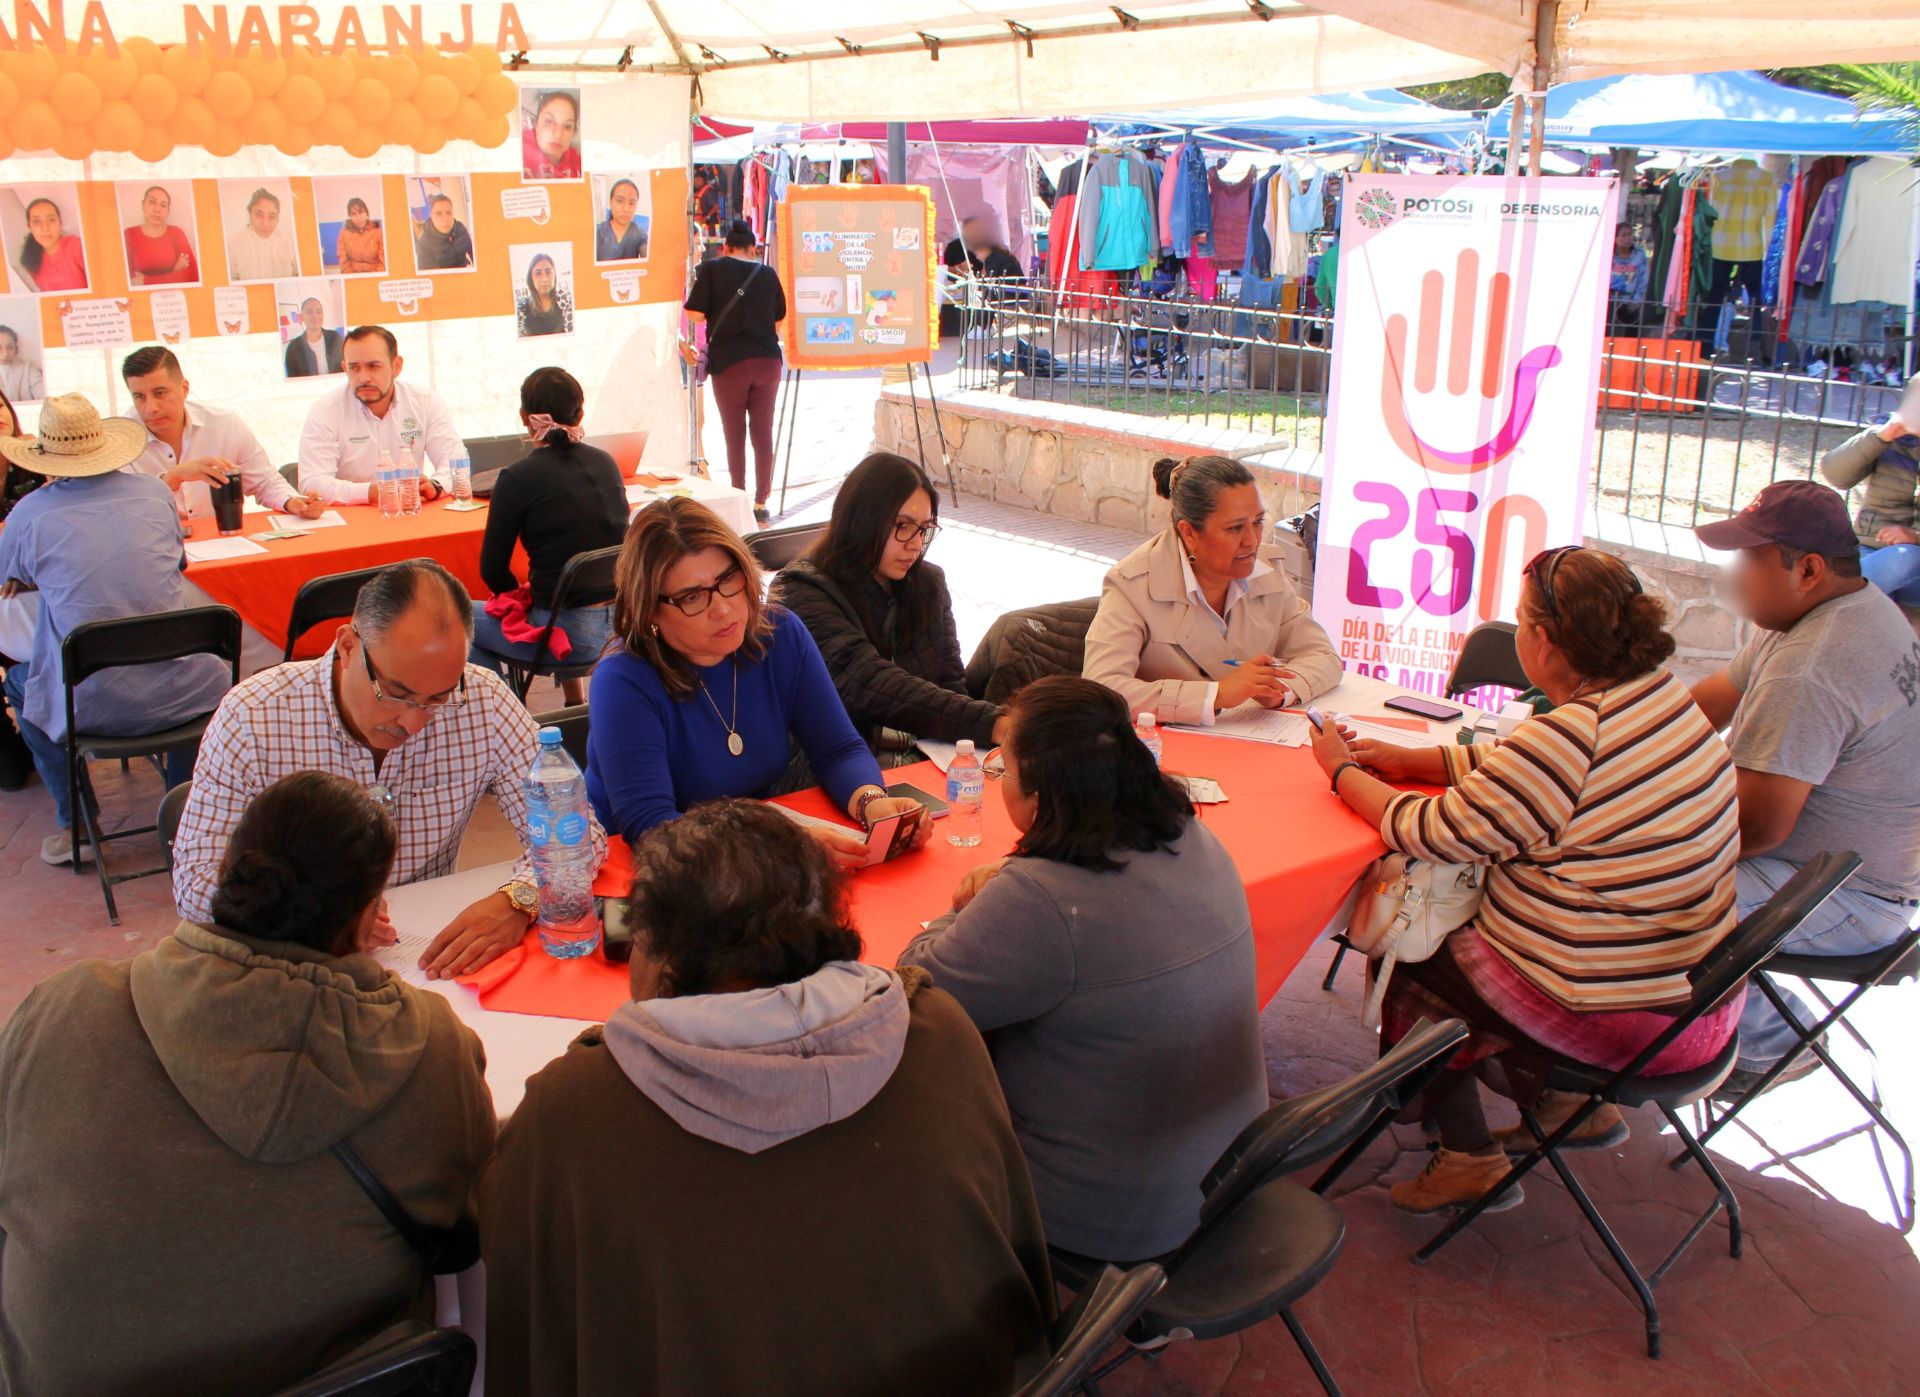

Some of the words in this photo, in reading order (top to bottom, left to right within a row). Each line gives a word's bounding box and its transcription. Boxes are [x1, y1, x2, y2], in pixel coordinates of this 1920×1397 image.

[183, 2, 532, 58] NARANJA
[1500, 202, 1600, 216] DEFENSORÍA
[1342, 616, 1369, 641] DÍA
[1373, 623, 1394, 643] DE
[1399, 625, 1419, 646] LA
[1341, 640, 1361, 659] DE
[1363, 643, 1382, 663] LA
